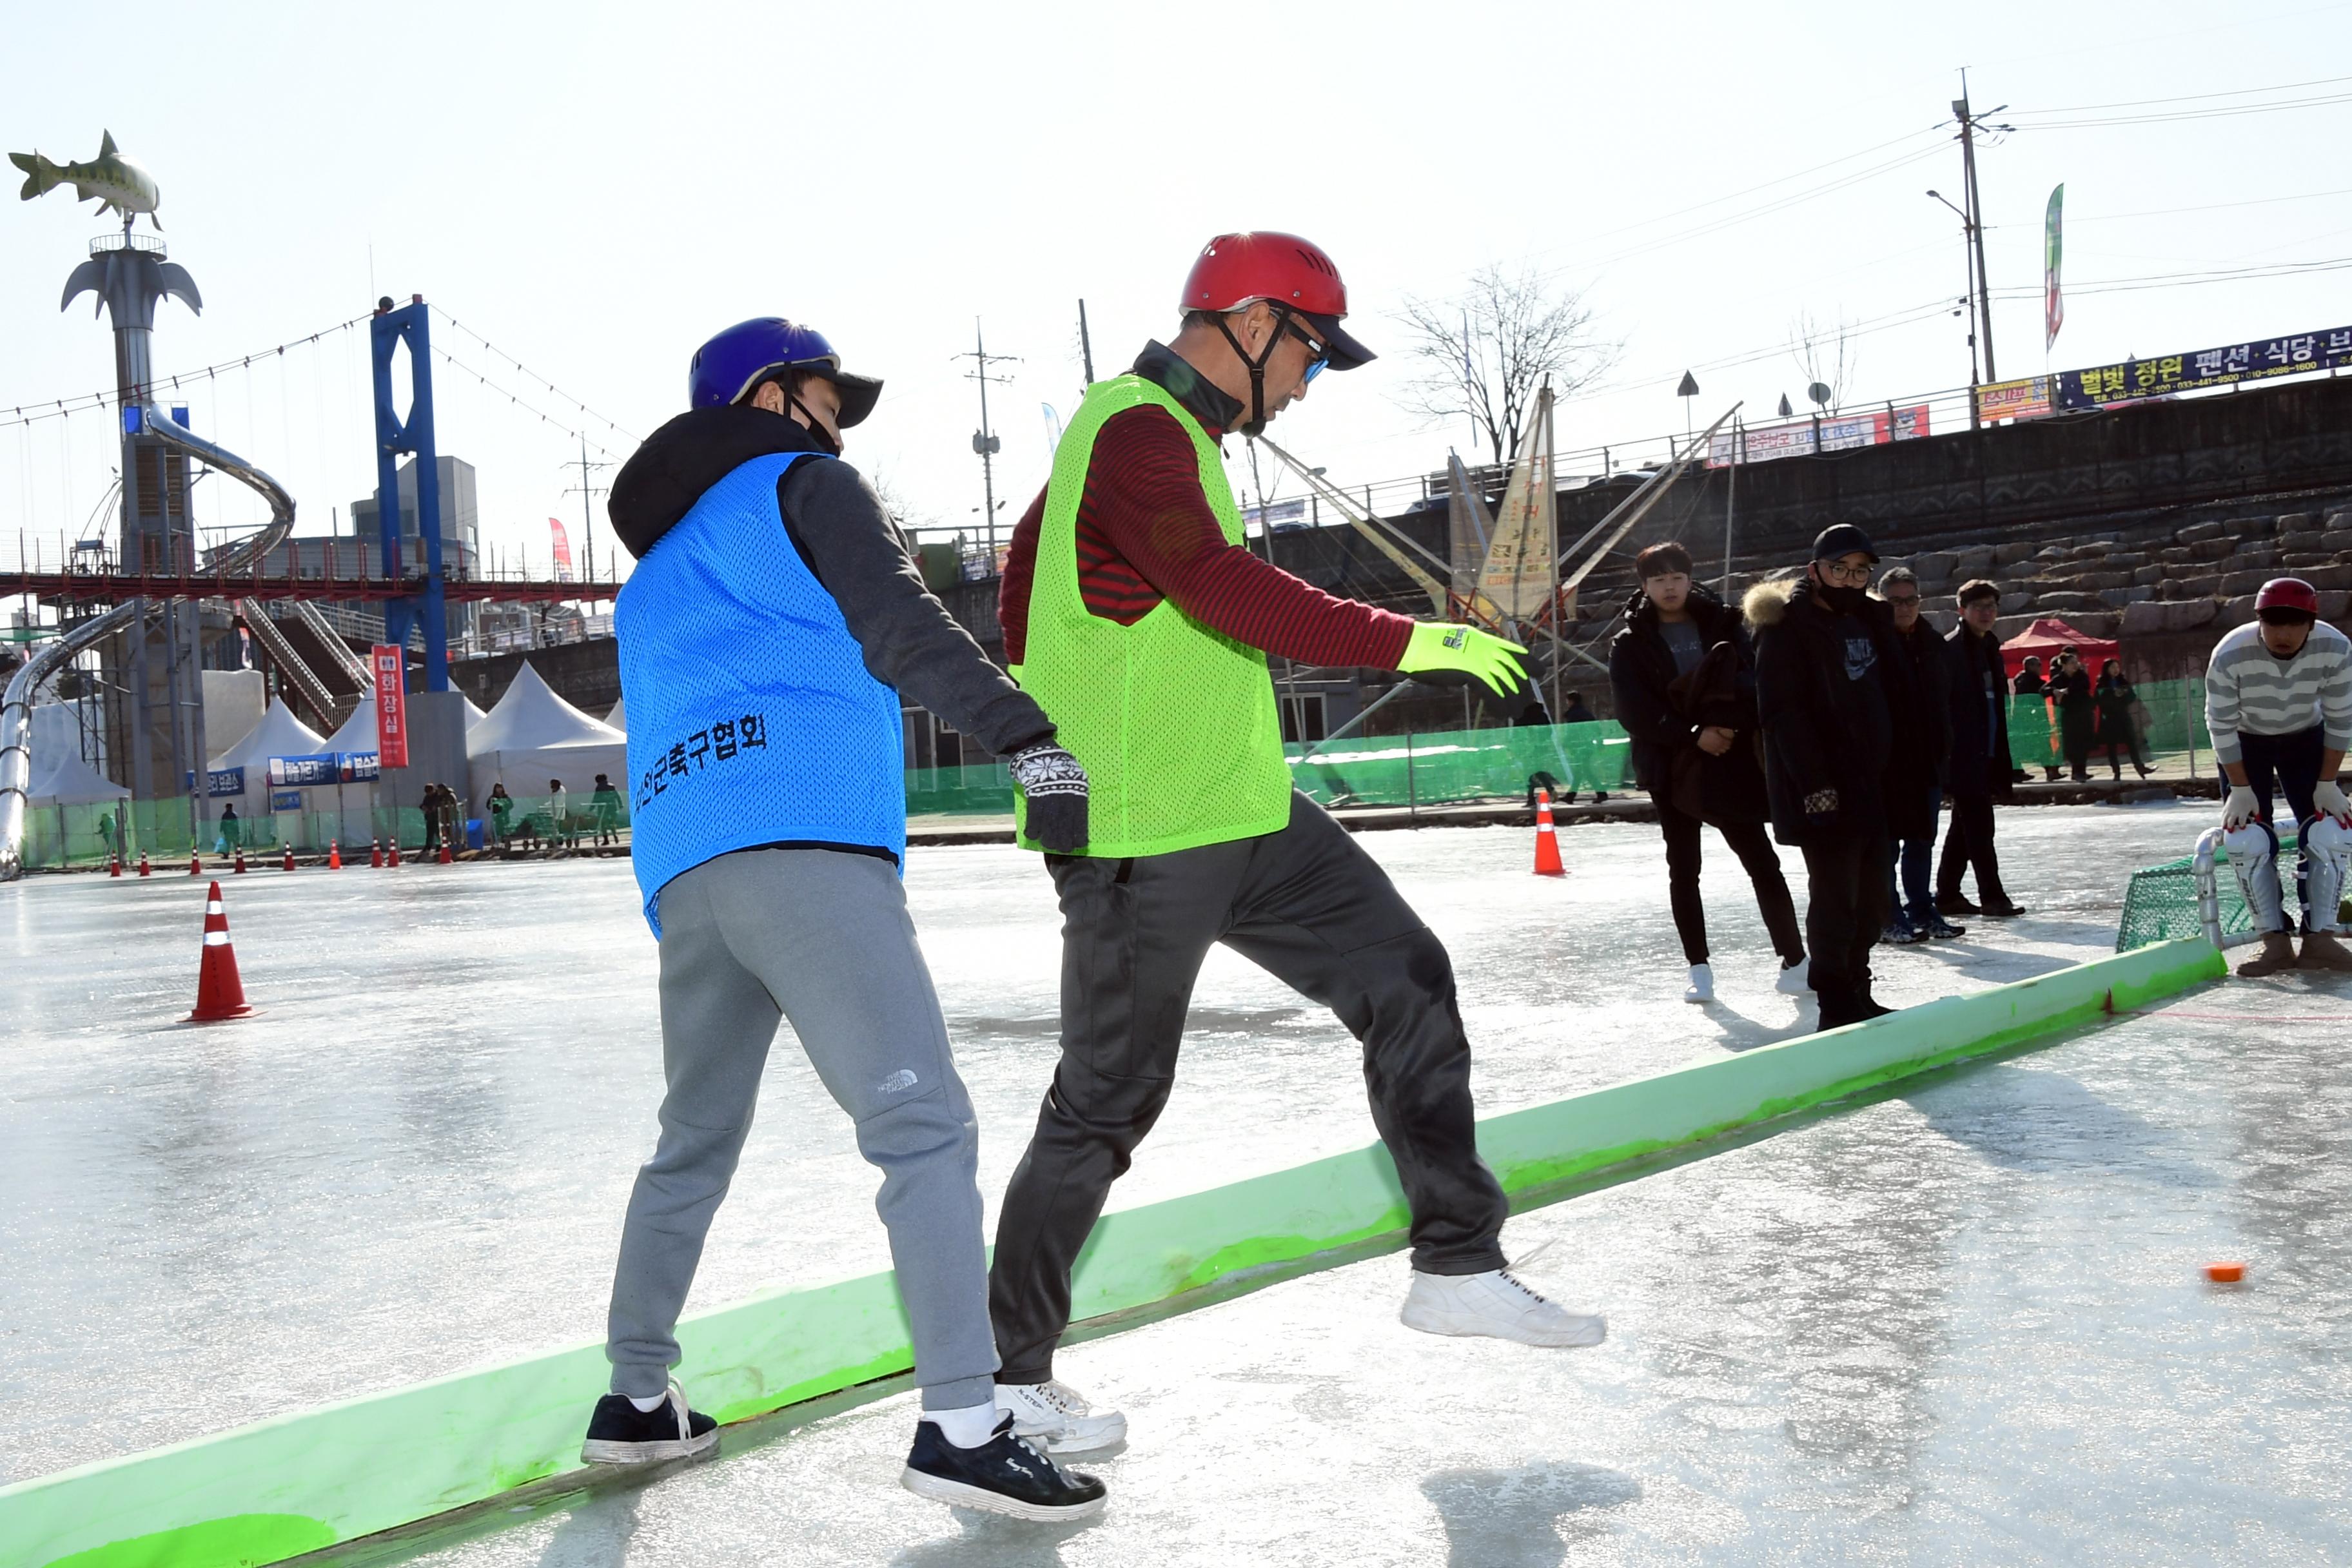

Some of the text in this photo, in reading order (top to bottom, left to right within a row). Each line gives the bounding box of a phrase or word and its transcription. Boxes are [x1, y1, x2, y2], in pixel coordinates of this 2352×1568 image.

[2080, 365, 2124, 395] 별빛
[2134, 356, 2183, 387] 정원
[2195, 344, 2249, 377] 펜션
[2264, 335, 2316, 364] 식당
[382, 673, 398, 733] 화장실
[1017, 1388, 1043, 1409] N-STEP
